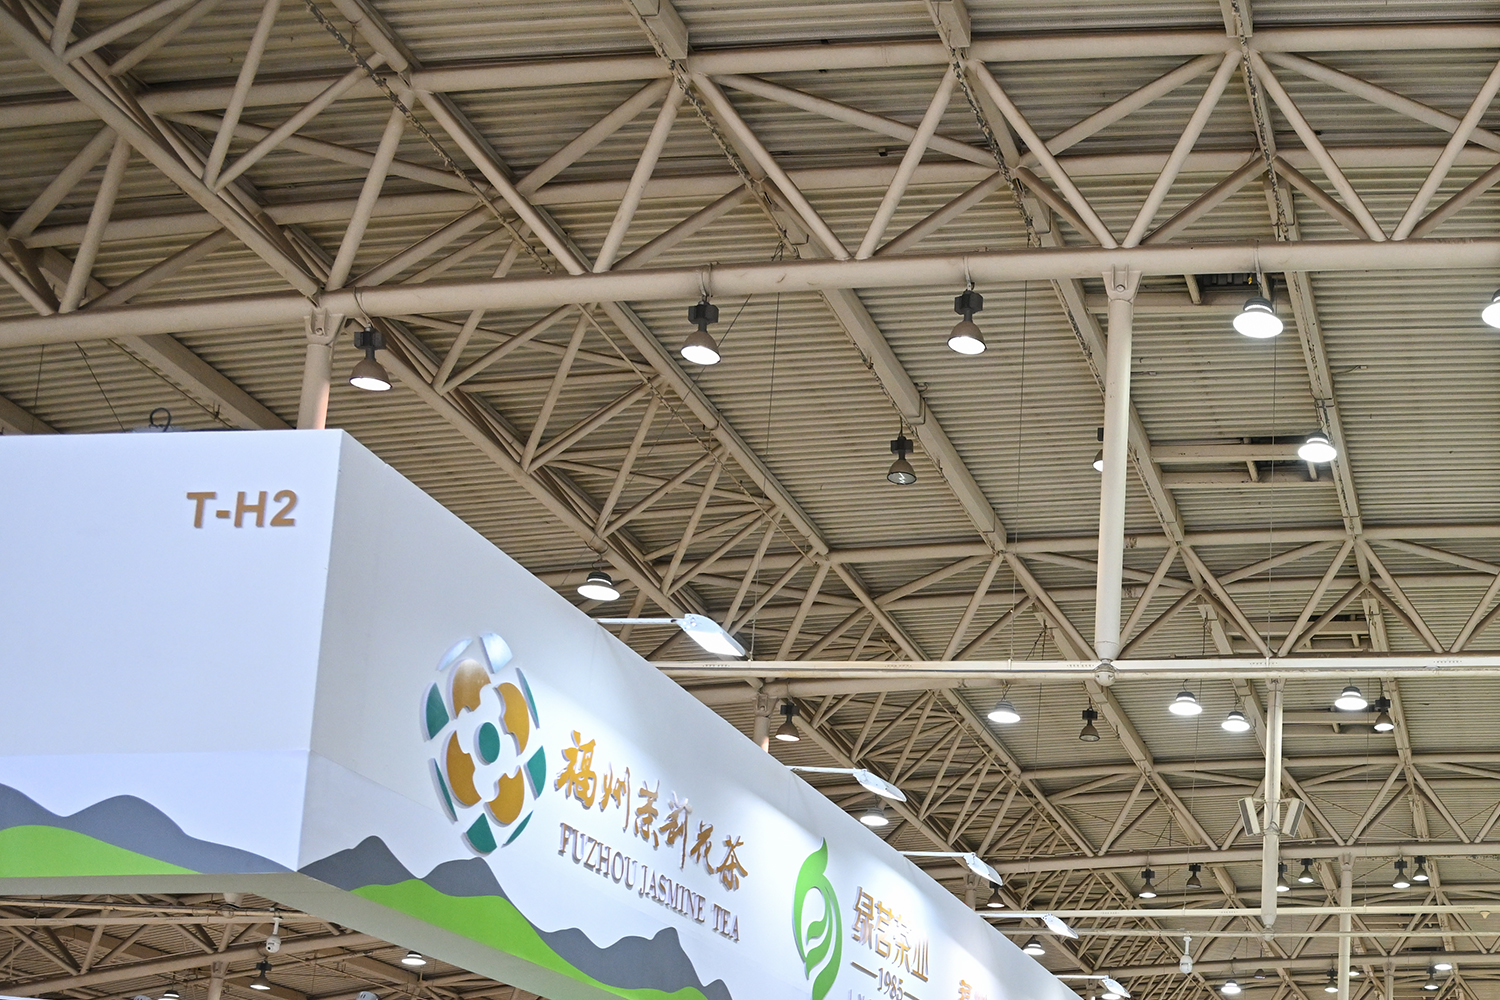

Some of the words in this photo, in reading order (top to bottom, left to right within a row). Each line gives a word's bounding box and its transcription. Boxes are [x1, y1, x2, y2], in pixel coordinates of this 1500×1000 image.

[187, 490, 298, 528] T-H2
[554, 729, 748, 891] 福州茉莉花茶
[558, 822, 638, 888] FUZHOU
[638, 865, 706, 925] JASMINE
[712, 903, 740, 942] TEA
[851, 886, 929, 982] 绿茗茶业
